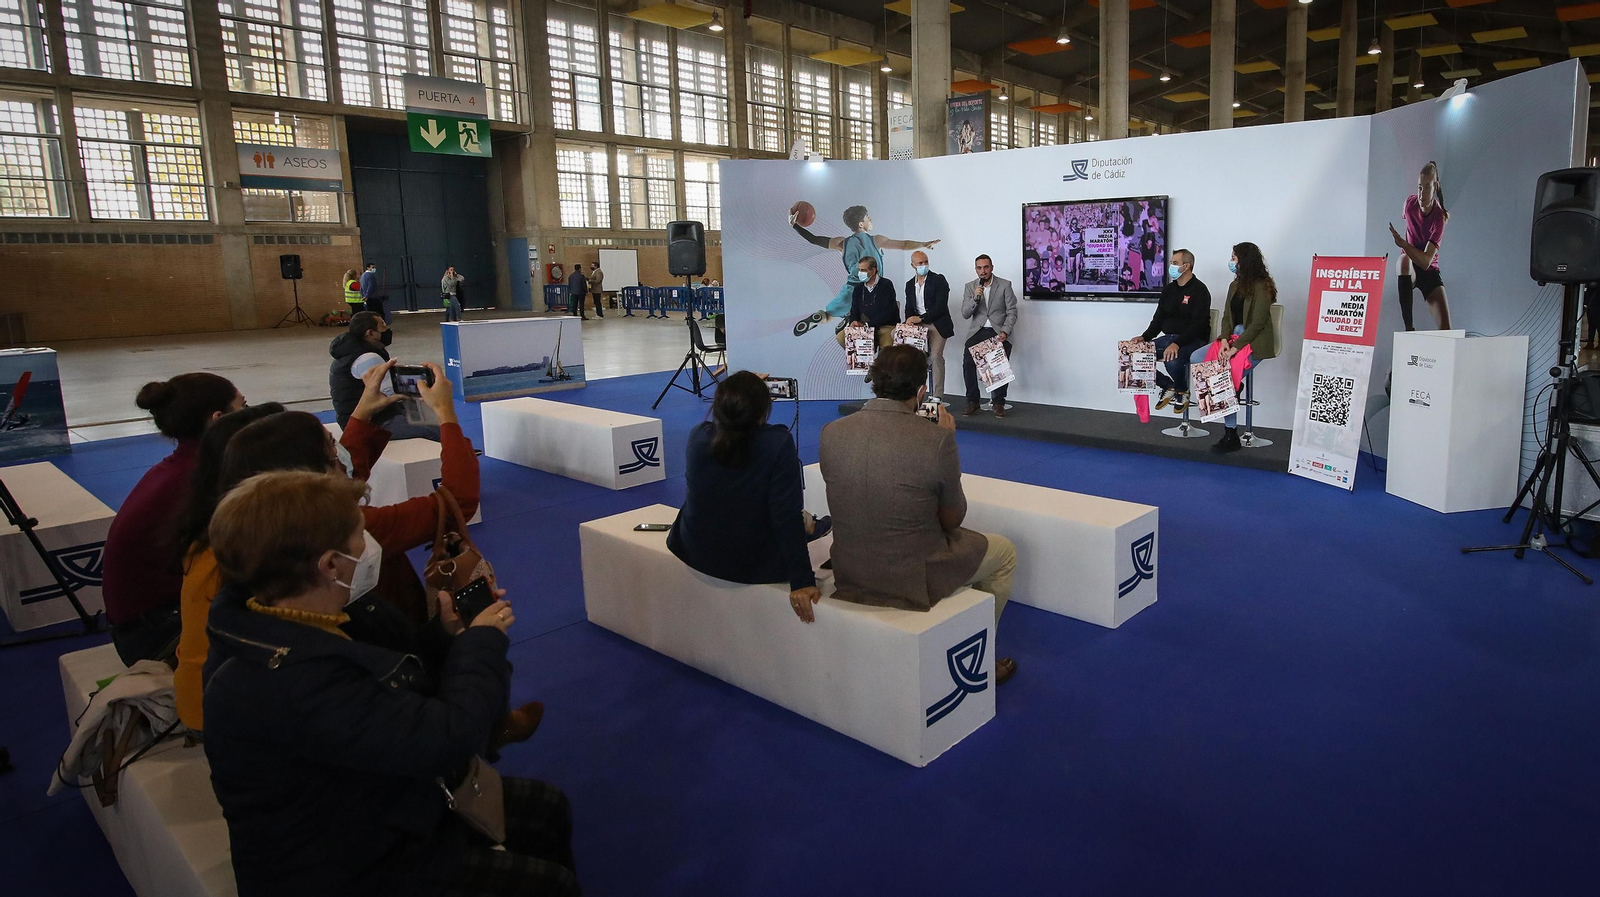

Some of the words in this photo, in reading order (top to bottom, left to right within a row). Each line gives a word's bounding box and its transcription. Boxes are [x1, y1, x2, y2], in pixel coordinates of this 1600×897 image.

[418, 89, 461, 105] PUERTA
[468, 96, 476, 106] 4
[890, 115, 913, 125] IFECA
[283, 156, 328, 170] ASEOS
[1091, 156, 1133, 168] Diputación
[1091, 171, 1102, 180] de
[1104, 169, 1126, 180] Cádiz
[1316, 267, 1380, 280] INSCRÍBETE
[1329, 279, 1344, 289] EN
[1347, 280, 1362, 290] LA
[1350, 294, 1366, 302] XXV
[1341, 302, 1364, 310] MEDIA
[1327, 308, 1364, 318] MARATÓN
[1353, 318, 1363, 326] DE
